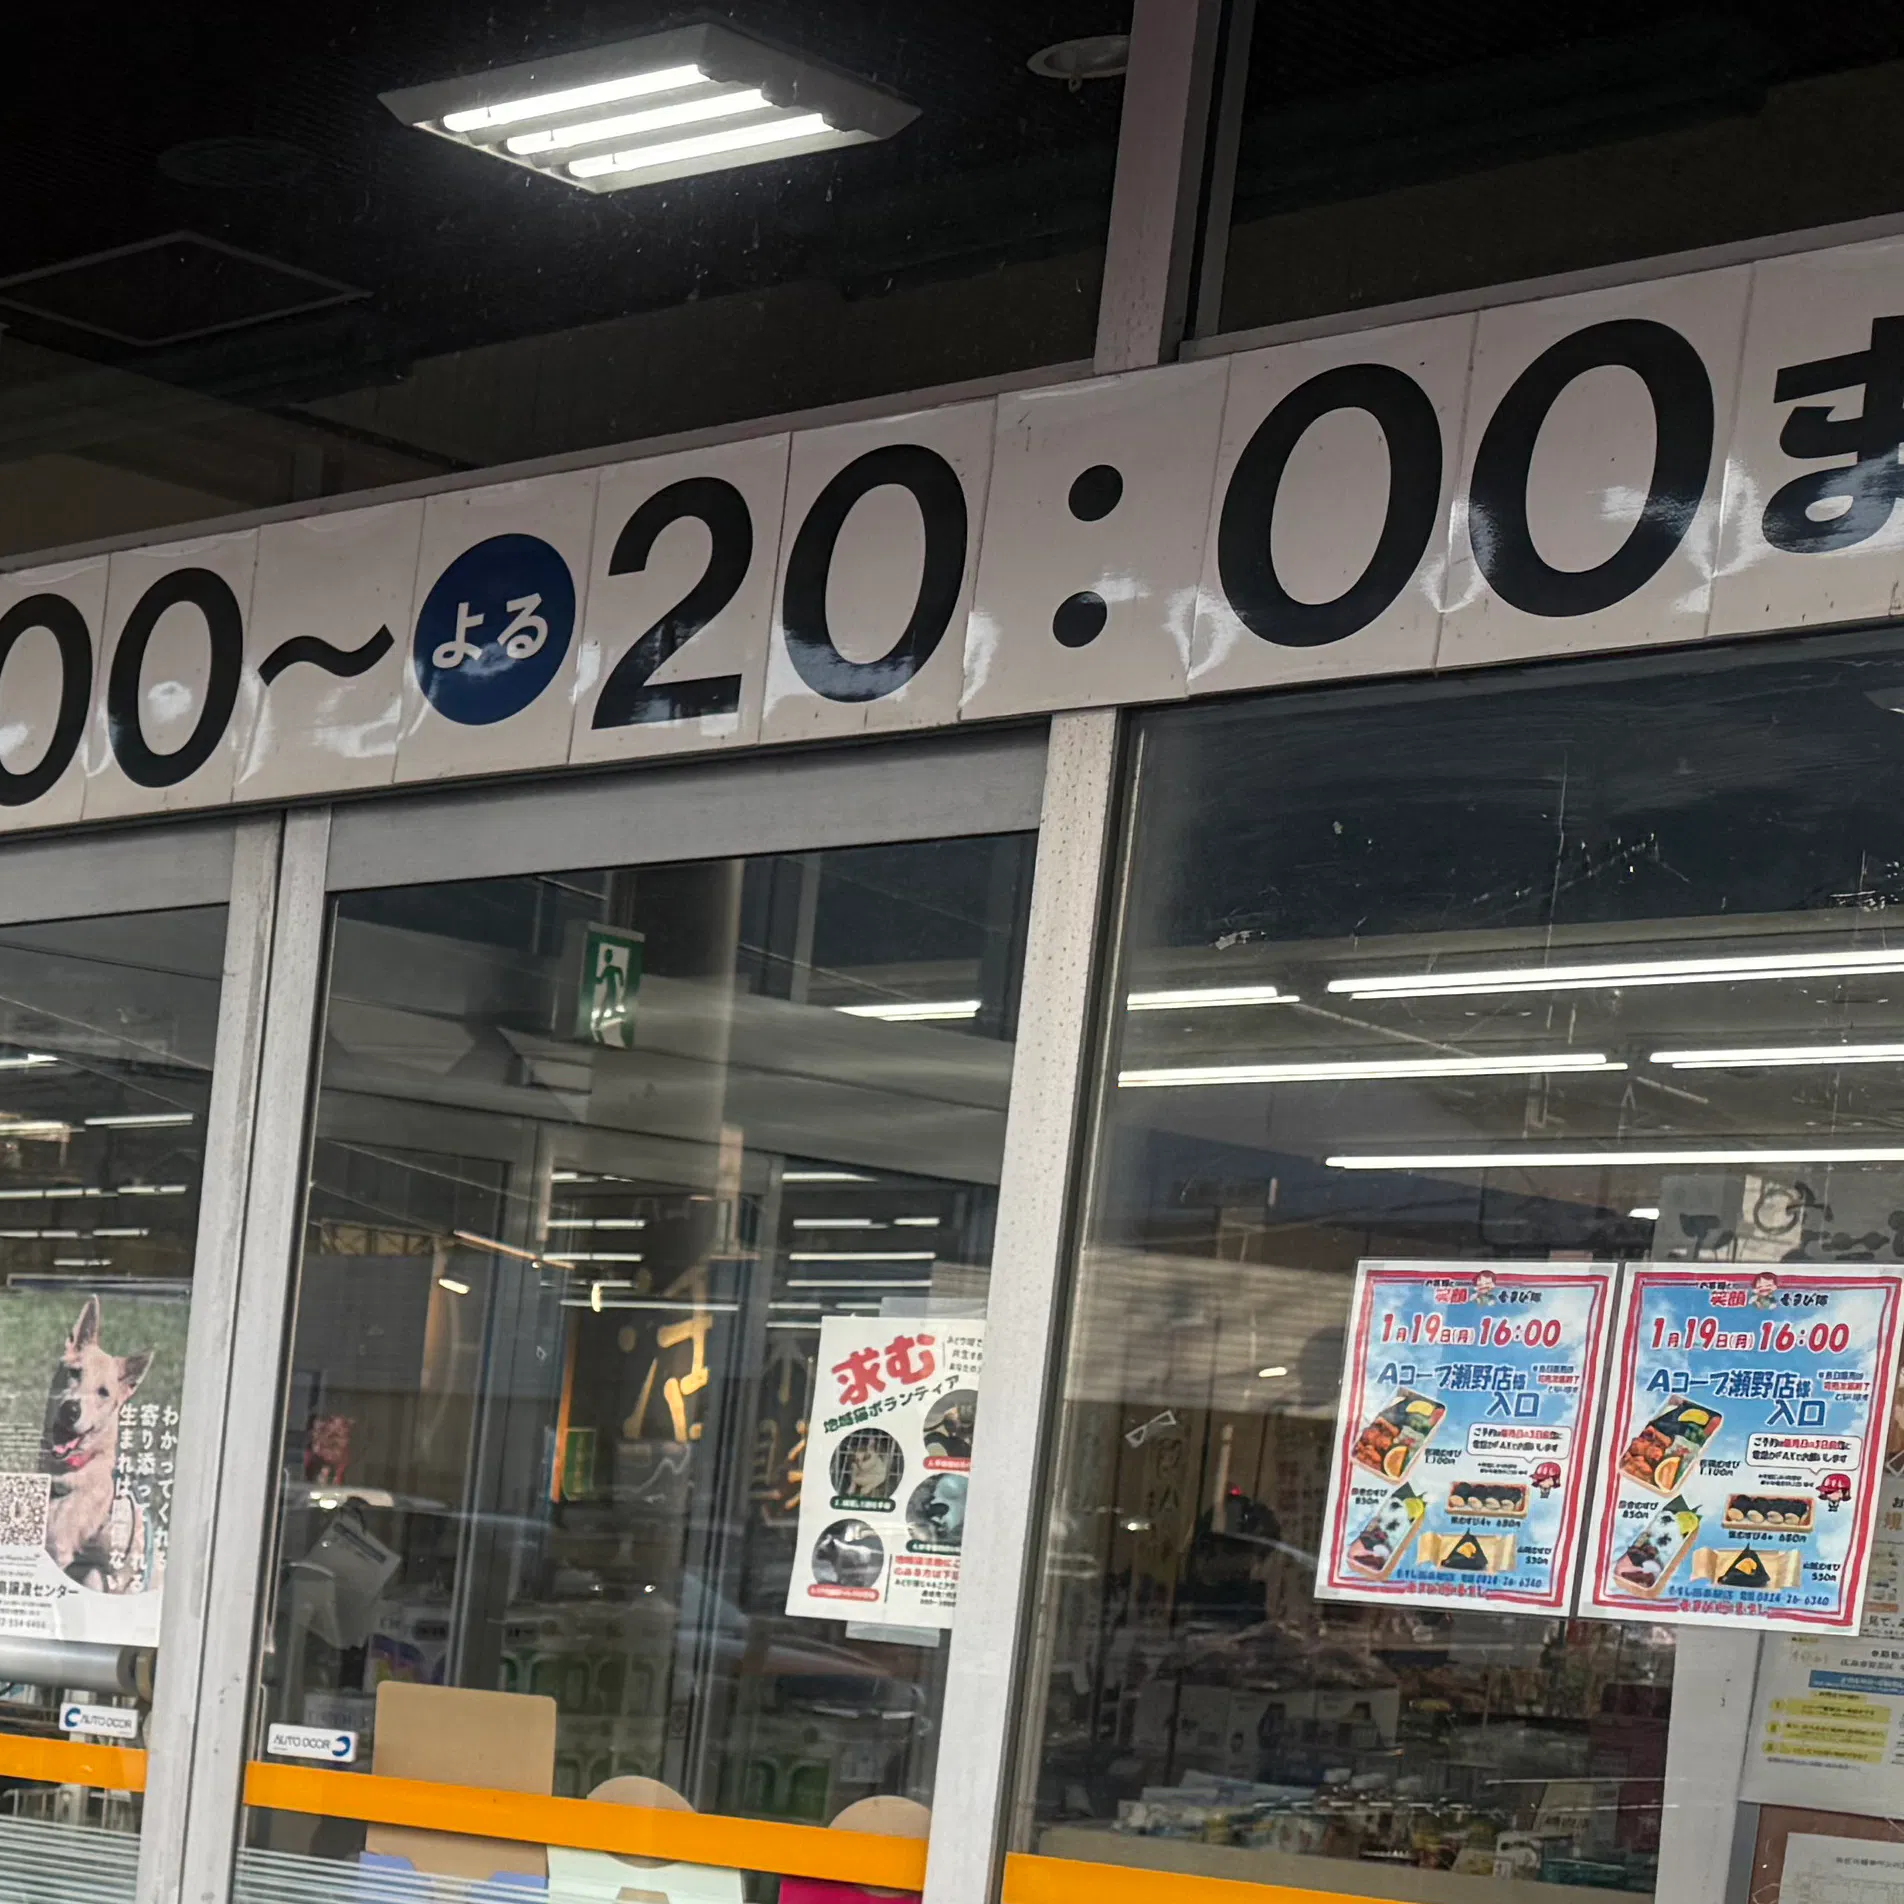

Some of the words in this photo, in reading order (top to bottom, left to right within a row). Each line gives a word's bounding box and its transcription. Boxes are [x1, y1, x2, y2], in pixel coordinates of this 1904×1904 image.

[431, 592, 550, 671] よる
[1479, 1317, 1562, 1348] 16:00
[1759, 1321, 1850, 1353] 16:00
[831, 1333, 936, 1405] 求む
[1486, 1391, 1540, 1418] 入口
[1766, 1400, 1827, 1427] 入口
[272, 1734, 300, 1746] AUTO
[301, 1737, 331, 1749] DOOR
